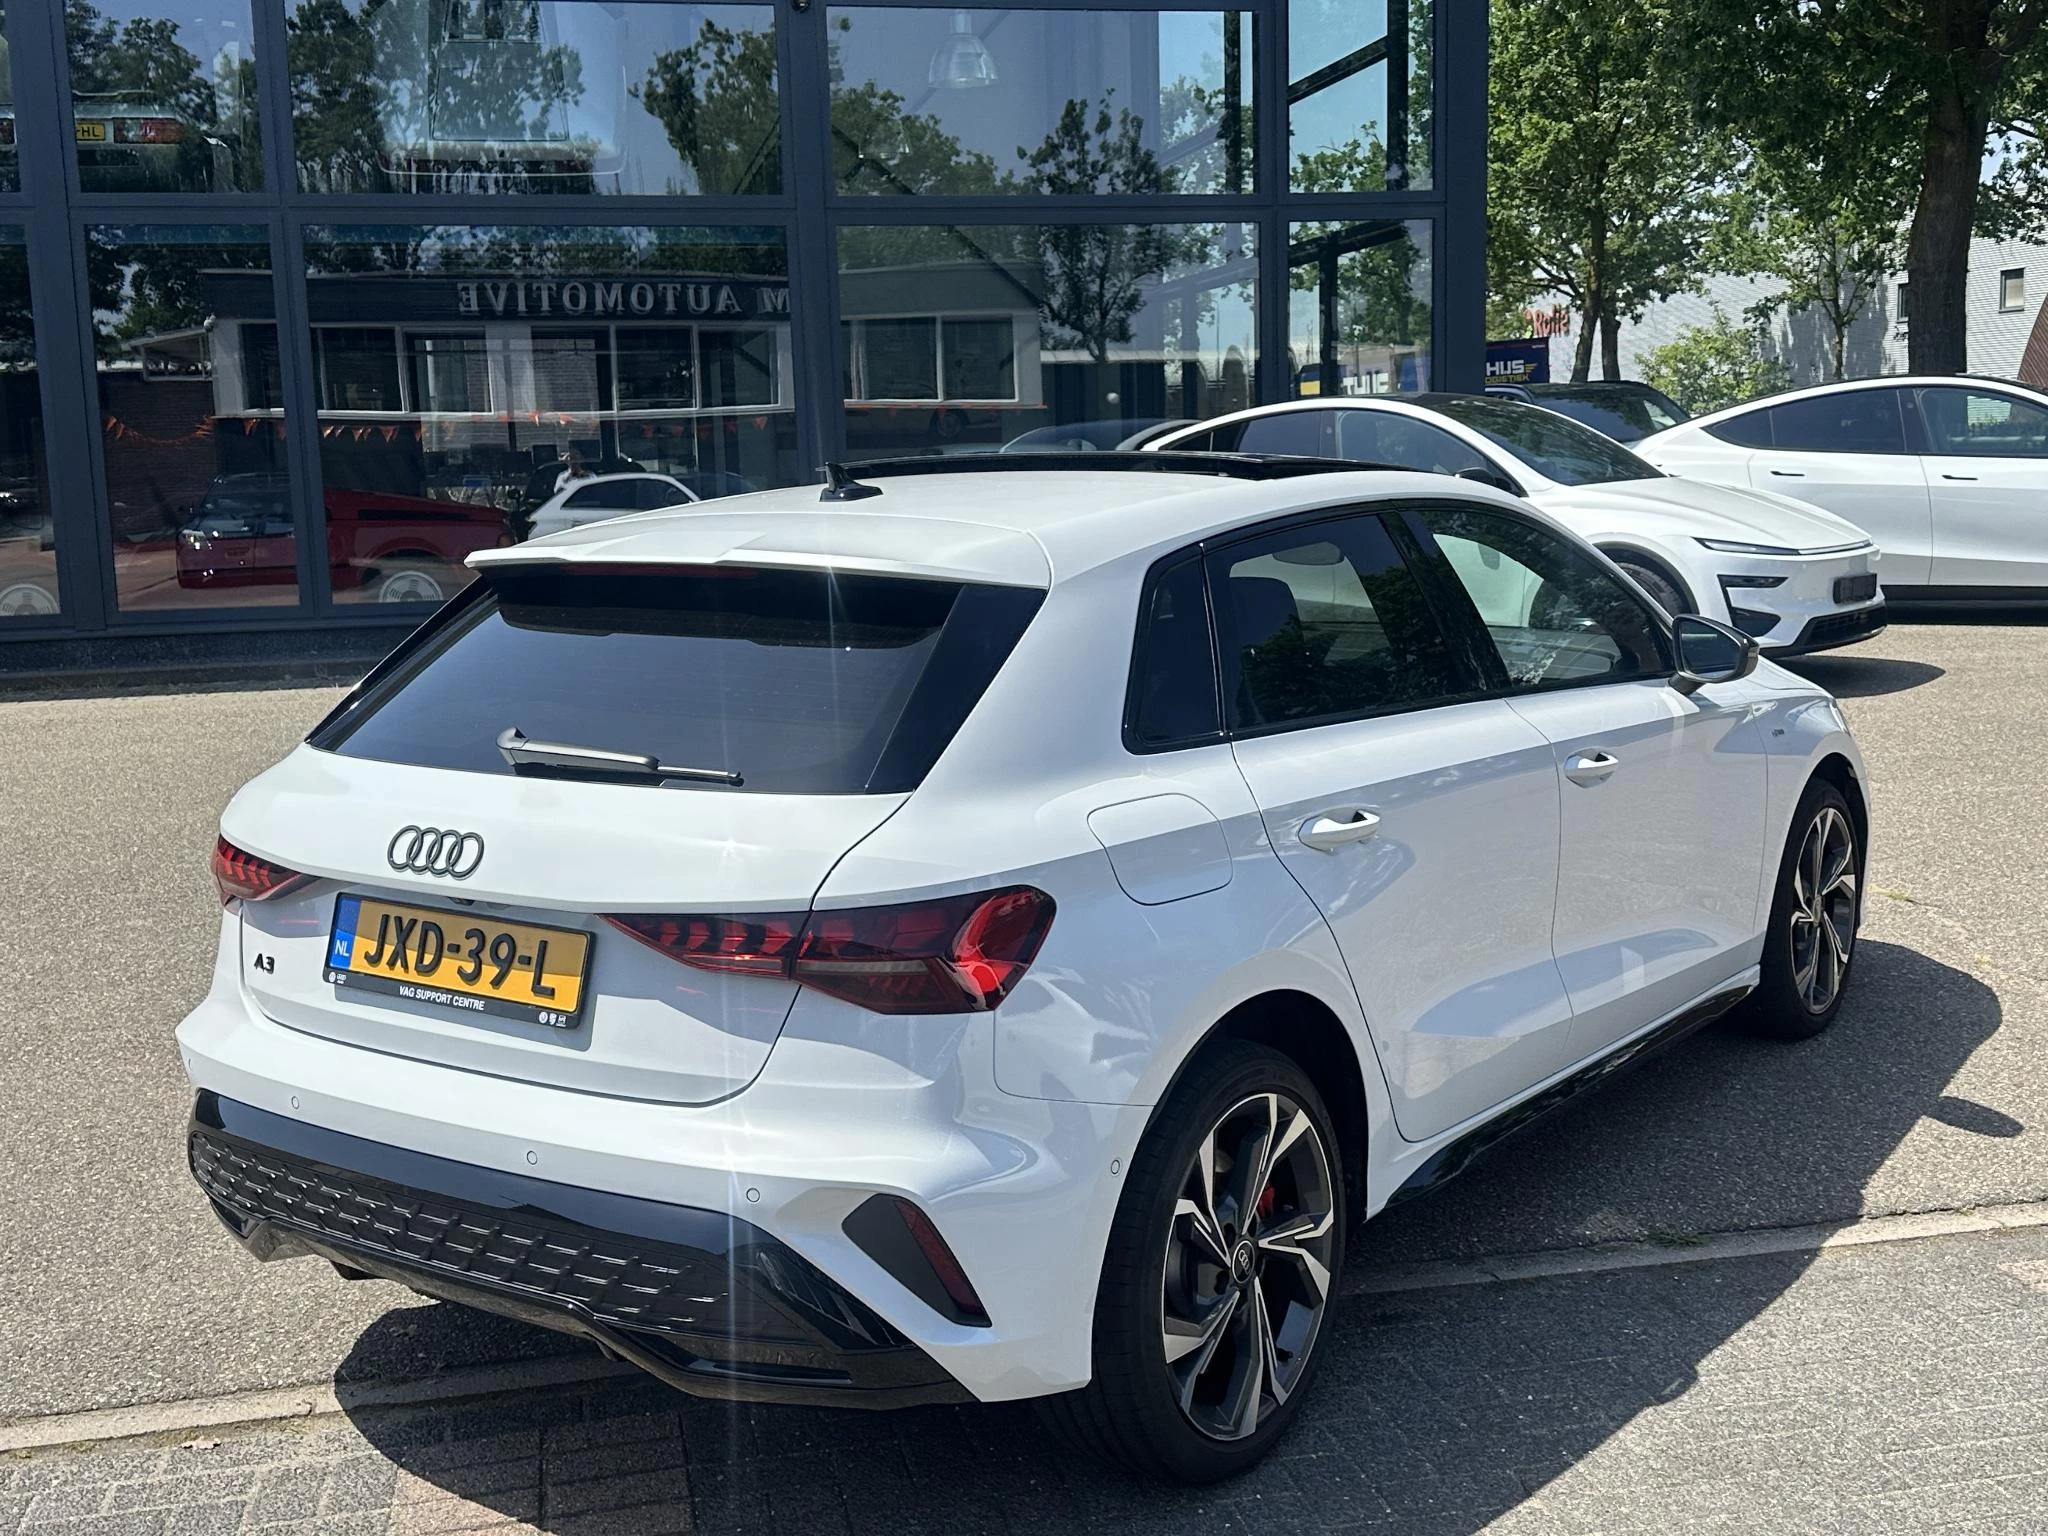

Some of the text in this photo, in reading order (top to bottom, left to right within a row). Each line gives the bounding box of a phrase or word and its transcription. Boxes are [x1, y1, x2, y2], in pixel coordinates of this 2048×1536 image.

[334, 938, 350, 957] NL
[363, 913, 557, 999] JXD-39-L
[253, 953, 275, 975] A3
[399, 985, 486, 1011] VAG SUPPORT CENTRE
